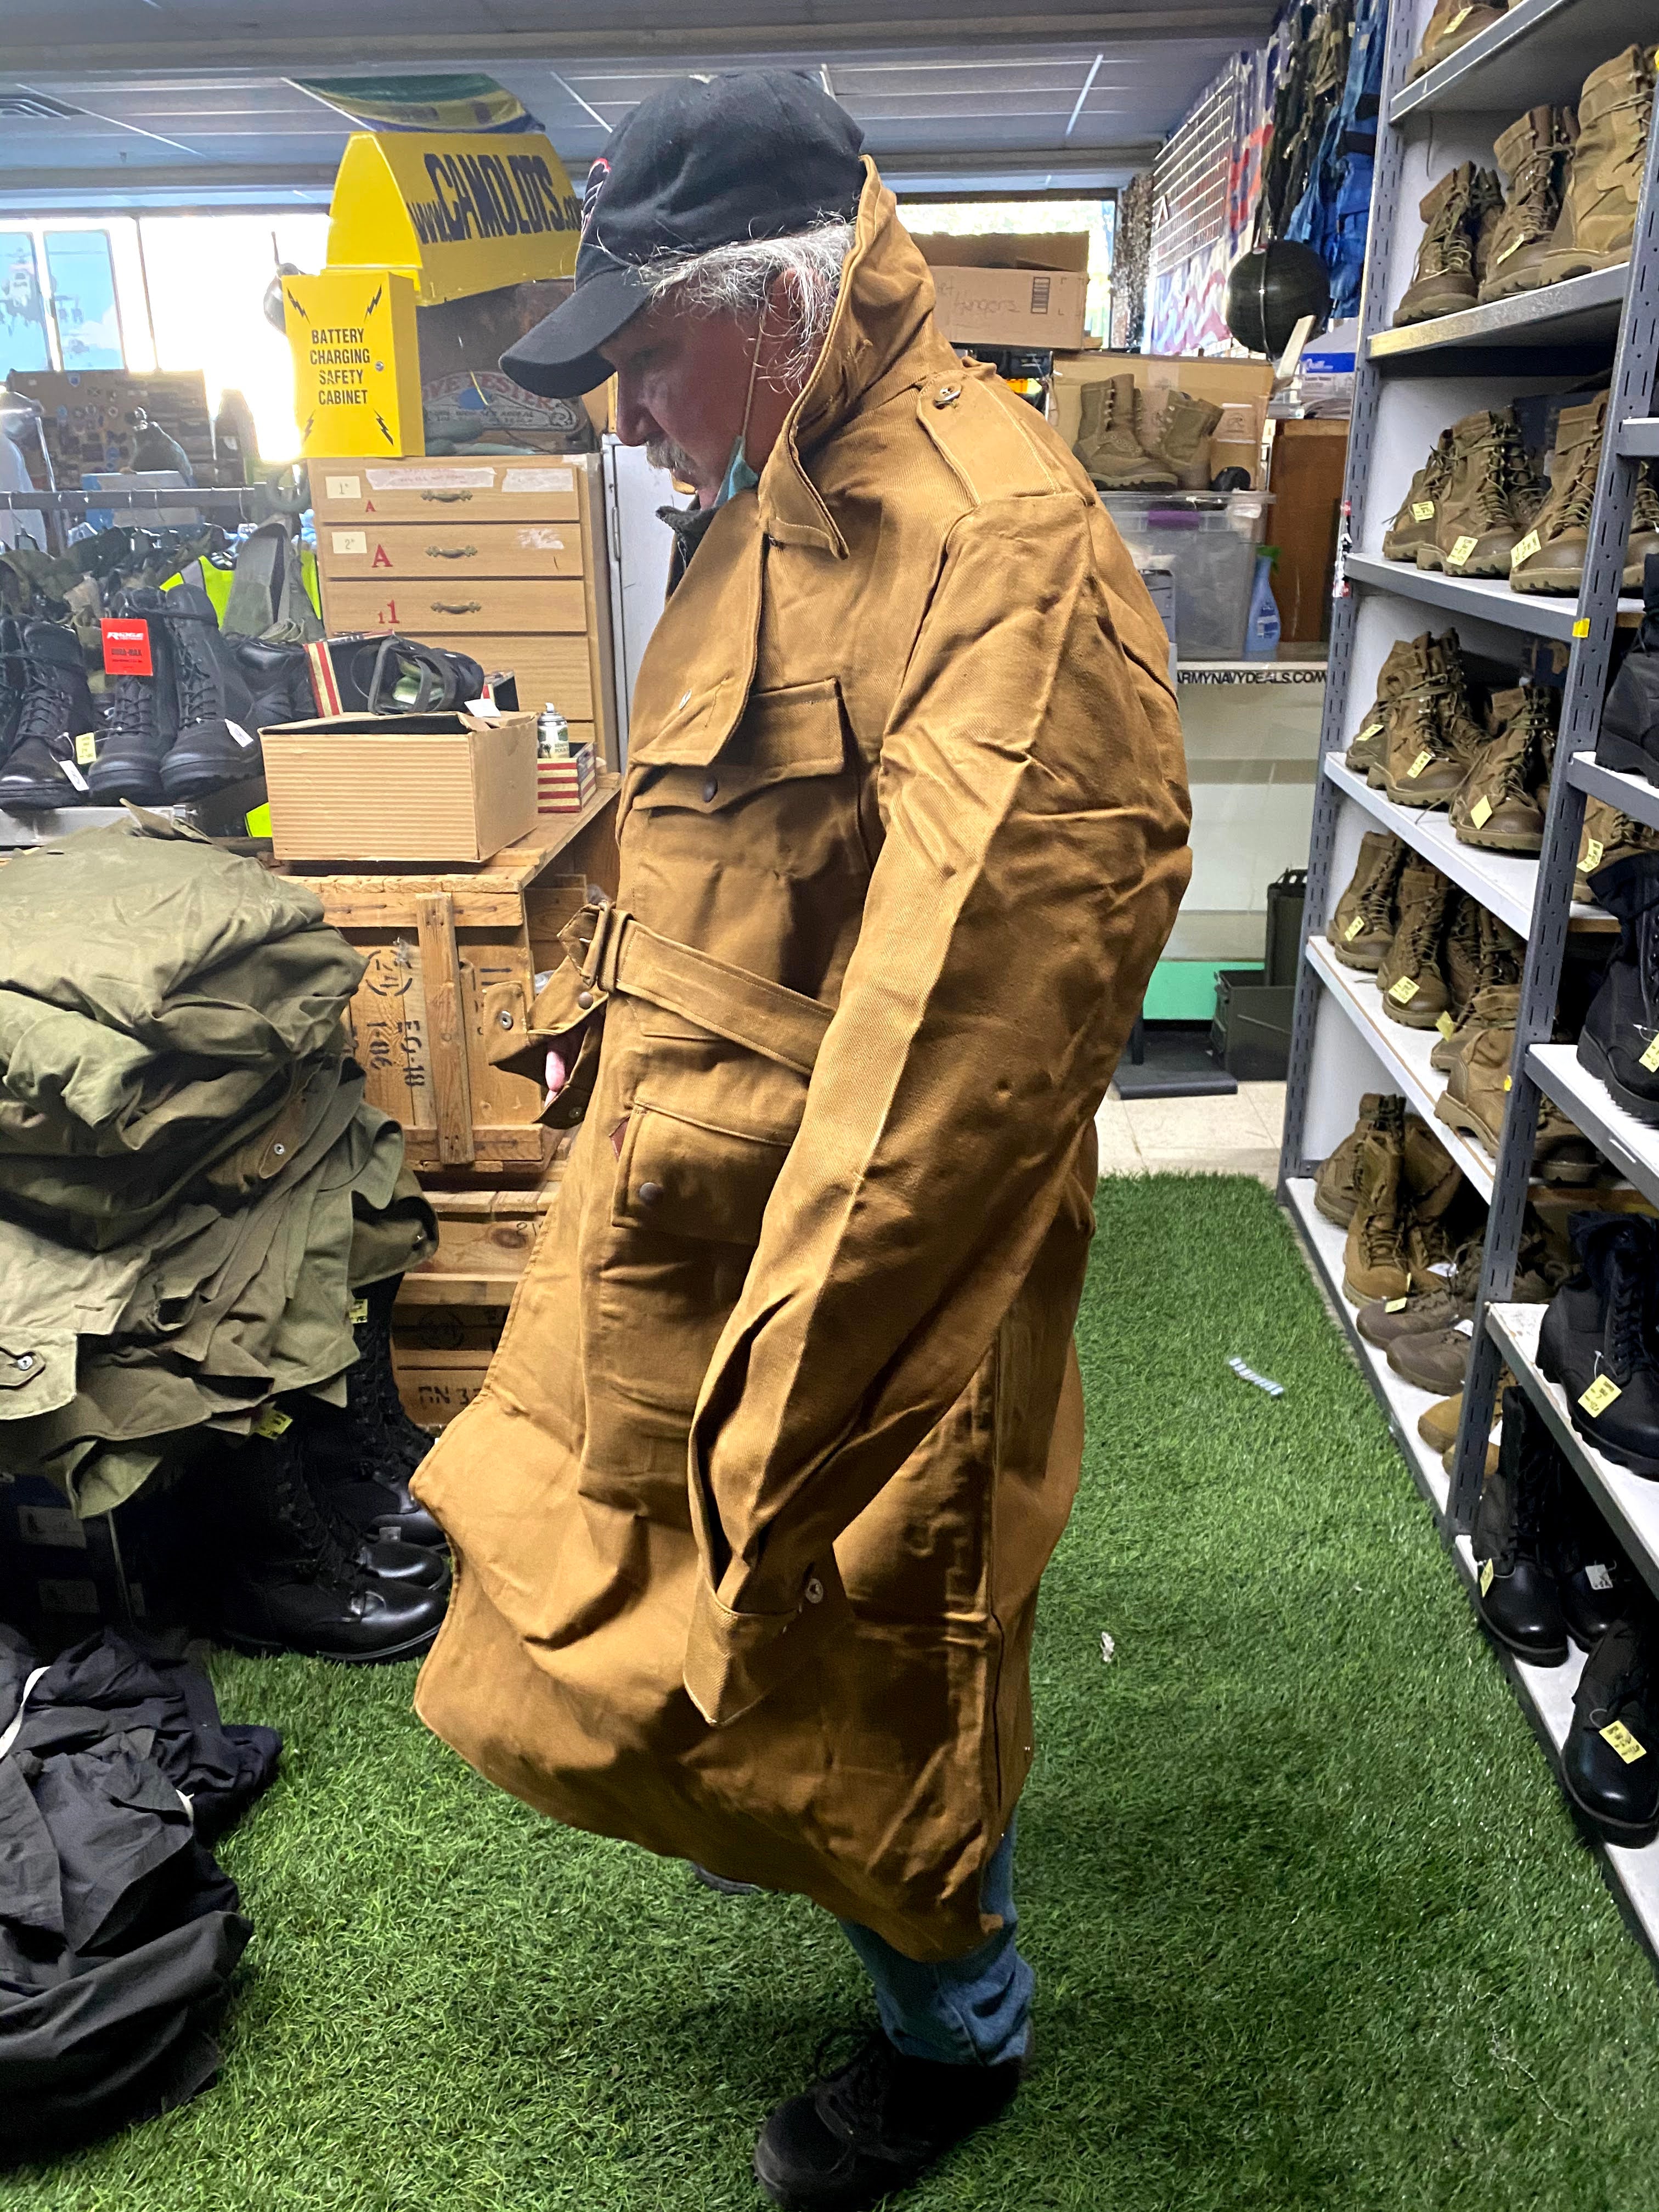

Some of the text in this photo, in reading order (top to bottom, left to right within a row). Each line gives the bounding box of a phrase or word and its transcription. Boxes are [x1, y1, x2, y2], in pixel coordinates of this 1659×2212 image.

[312, 328, 364, 344] BATTERY
[310, 348, 370, 365] CHARGING
[319, 369, 363, 385] SAFETY
[318, 390, 368, 405] CABINET
[365, 499, 376, 512] A
[371, 544, 393, 568] A
